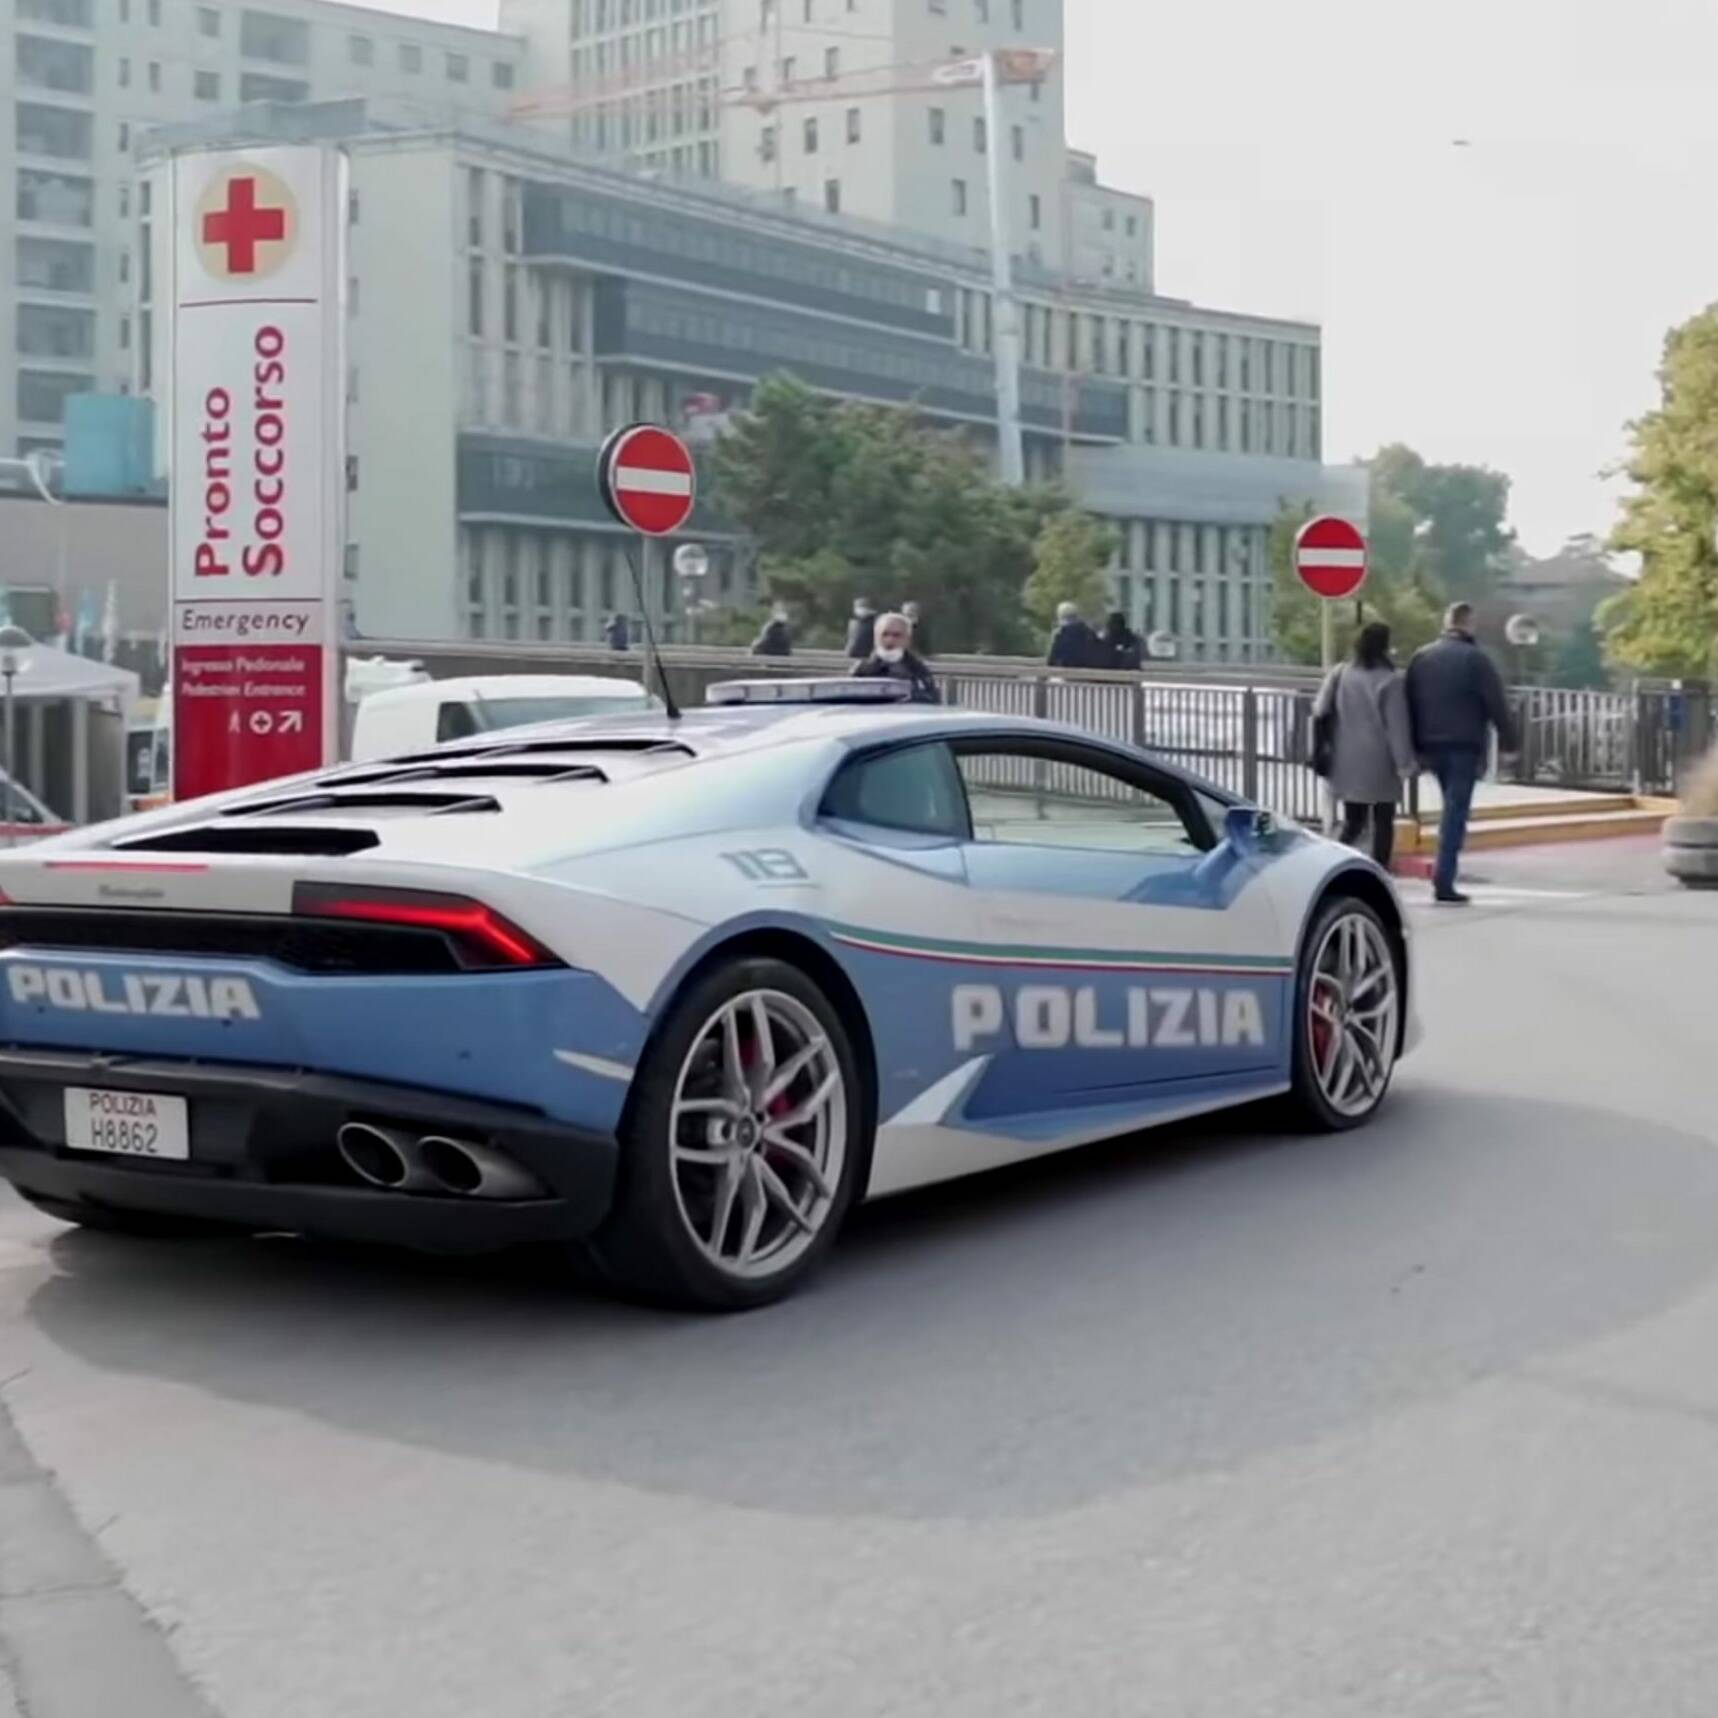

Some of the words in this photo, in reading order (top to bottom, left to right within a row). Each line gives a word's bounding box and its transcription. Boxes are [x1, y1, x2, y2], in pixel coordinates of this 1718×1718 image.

[242, 326, 284, 576] Soccorso
[195, 387, 230, 576] Pronto
[182, 609, 309, 635] Emergency
[8, 964, 261, 1019] POLIZIA
[952, 984, 1265, 1050] POLIZIA
[90, 1092, 157, 1117] POLIZIA
[92, 1117, 158, 1154] H8862
